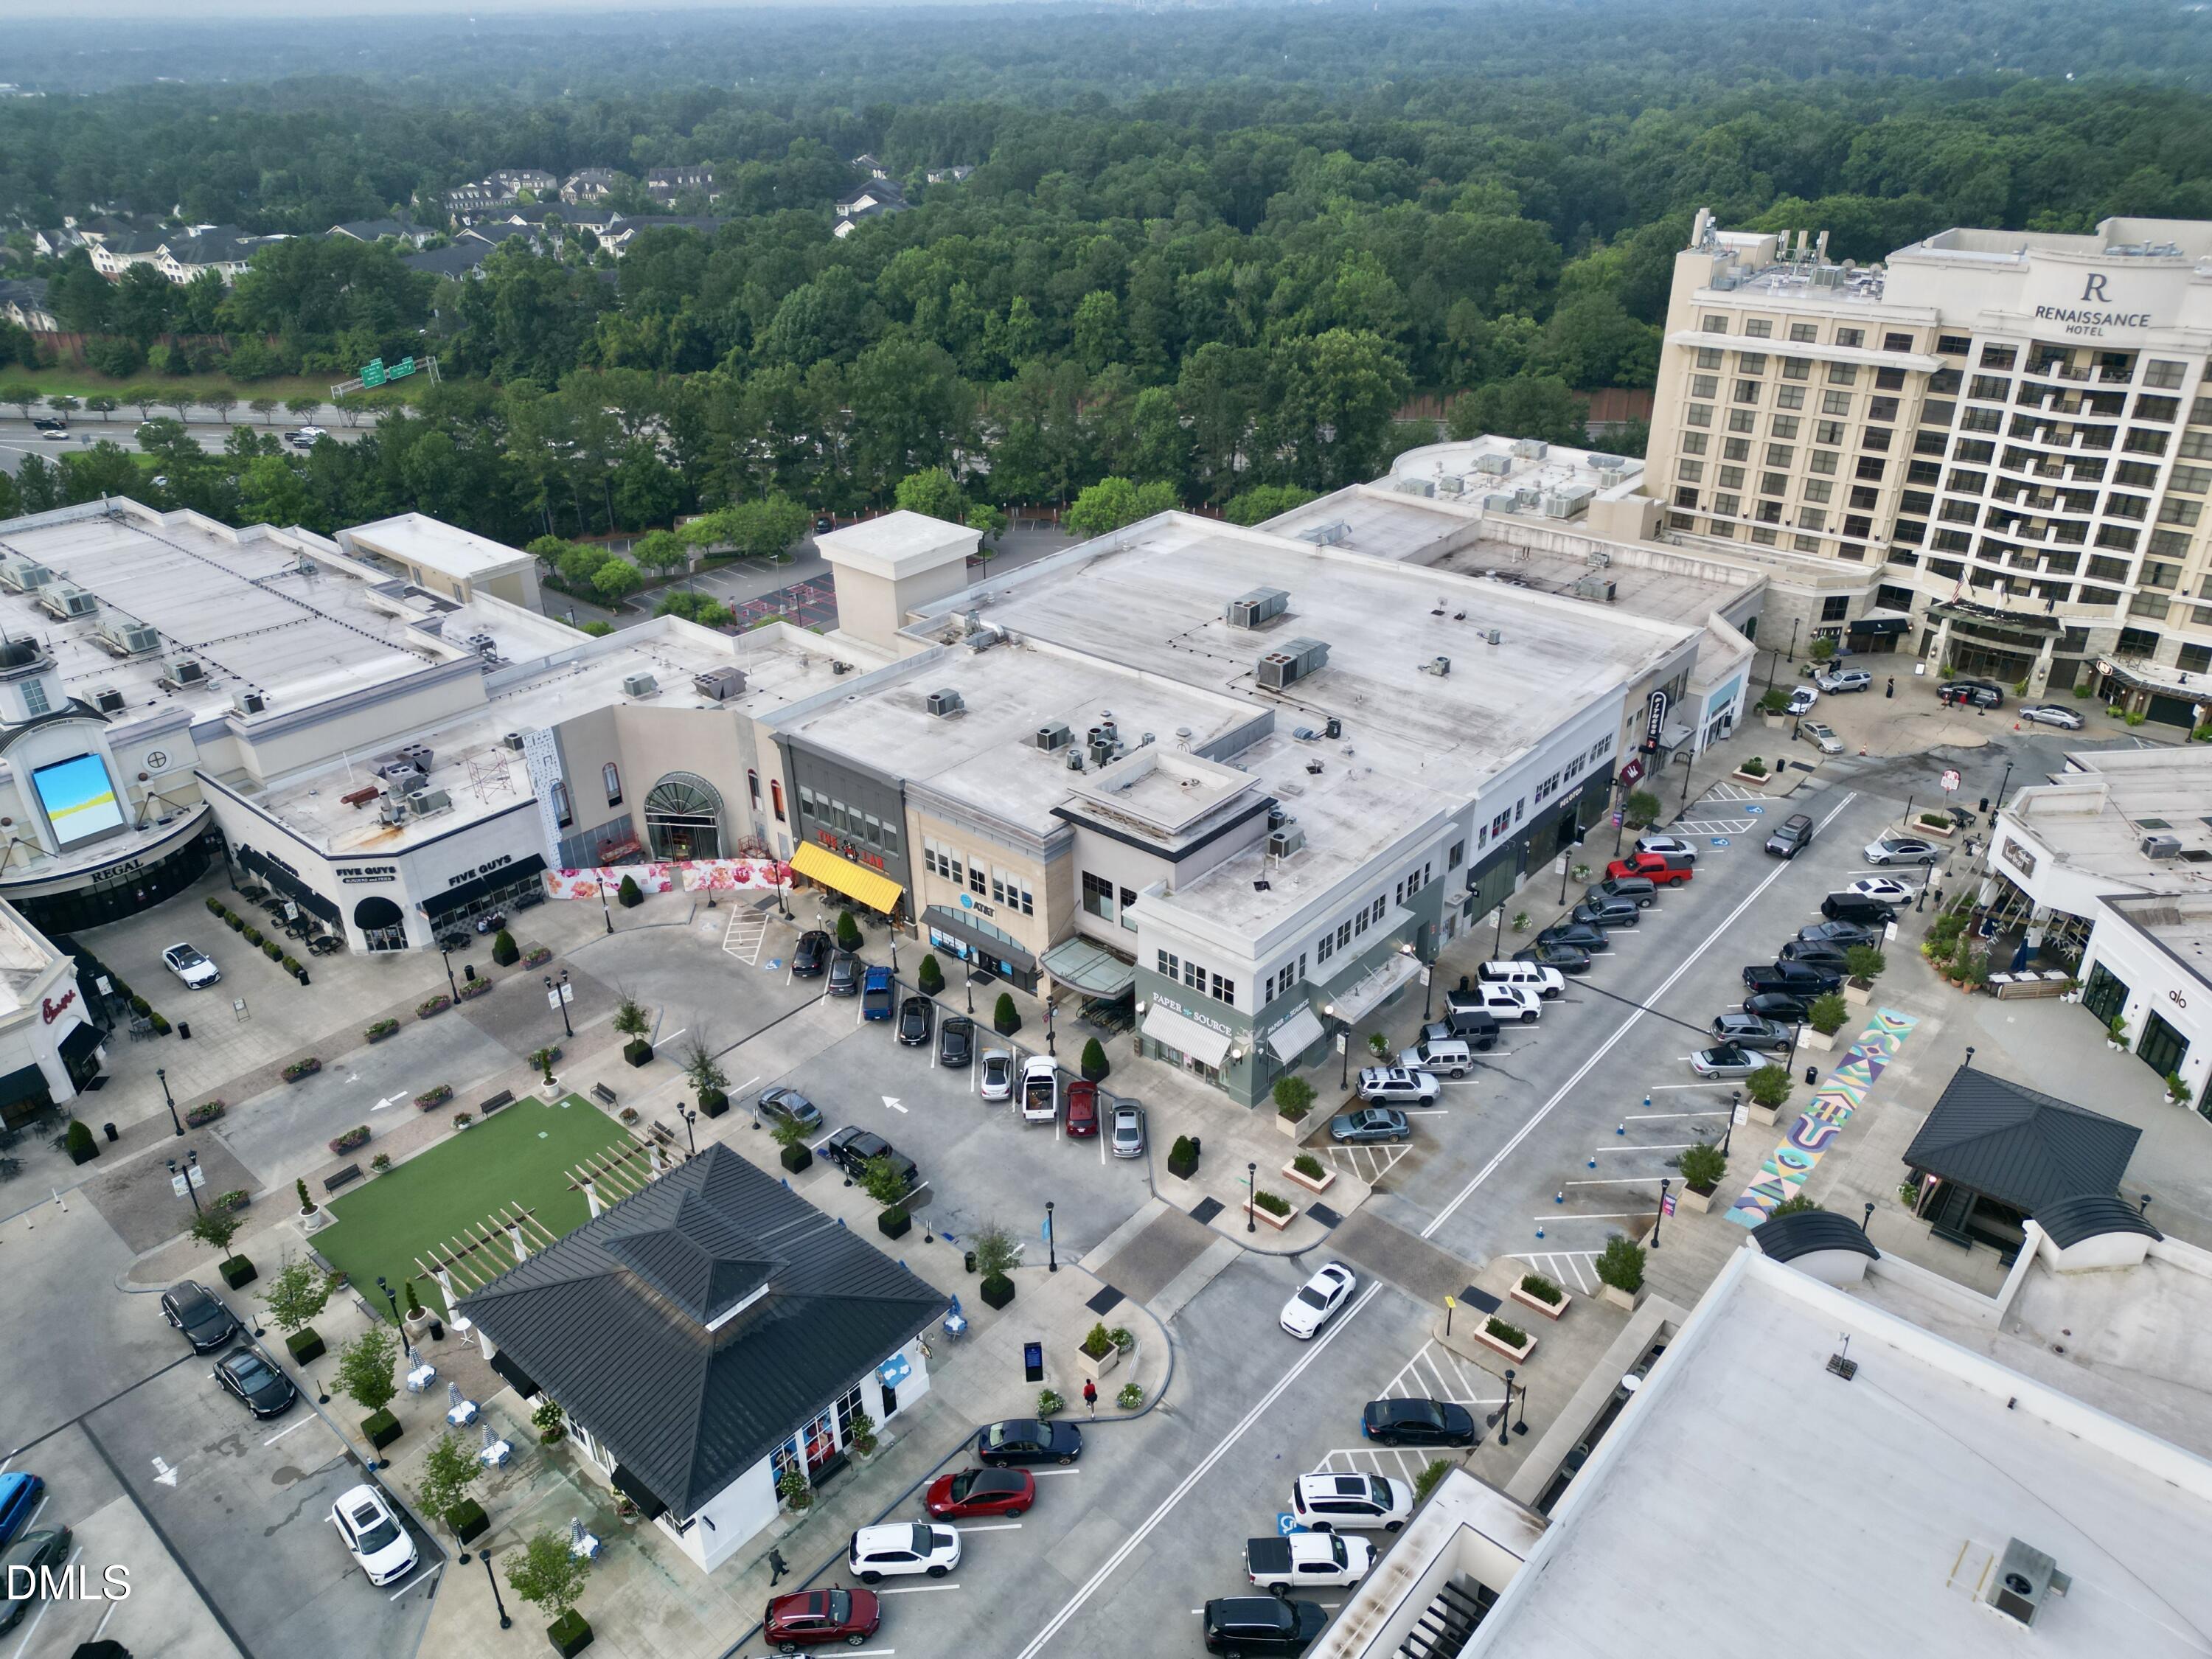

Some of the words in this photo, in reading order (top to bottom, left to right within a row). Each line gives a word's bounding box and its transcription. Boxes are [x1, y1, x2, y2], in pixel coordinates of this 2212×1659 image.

[2081, 273, 2112, 302] R
[2035, 305, 2151, 327] RENAISSANCE
[2065, 324, 2104, 337] HOTEL
[1650, 698, 1662, 734] FITNESS
[1559, 785, 1584, 809] PELOTON
[818, 828, 838, 849] THE
[90, 858, 144, 883] REGAL
[336, 868, 362, 876] FIVE
[364, 866, 396, 874] GUYS
[448, 869, 477, 887] FIVE
[479, 855, 512, 874] GUYS
[973, 901, 995, 917] AT&T
[2168, 990, 2187, 1009] alo
[1152, 992, 1182, 1012] PAPER
[1193, 1012, 1232, 1036] SOURCE
